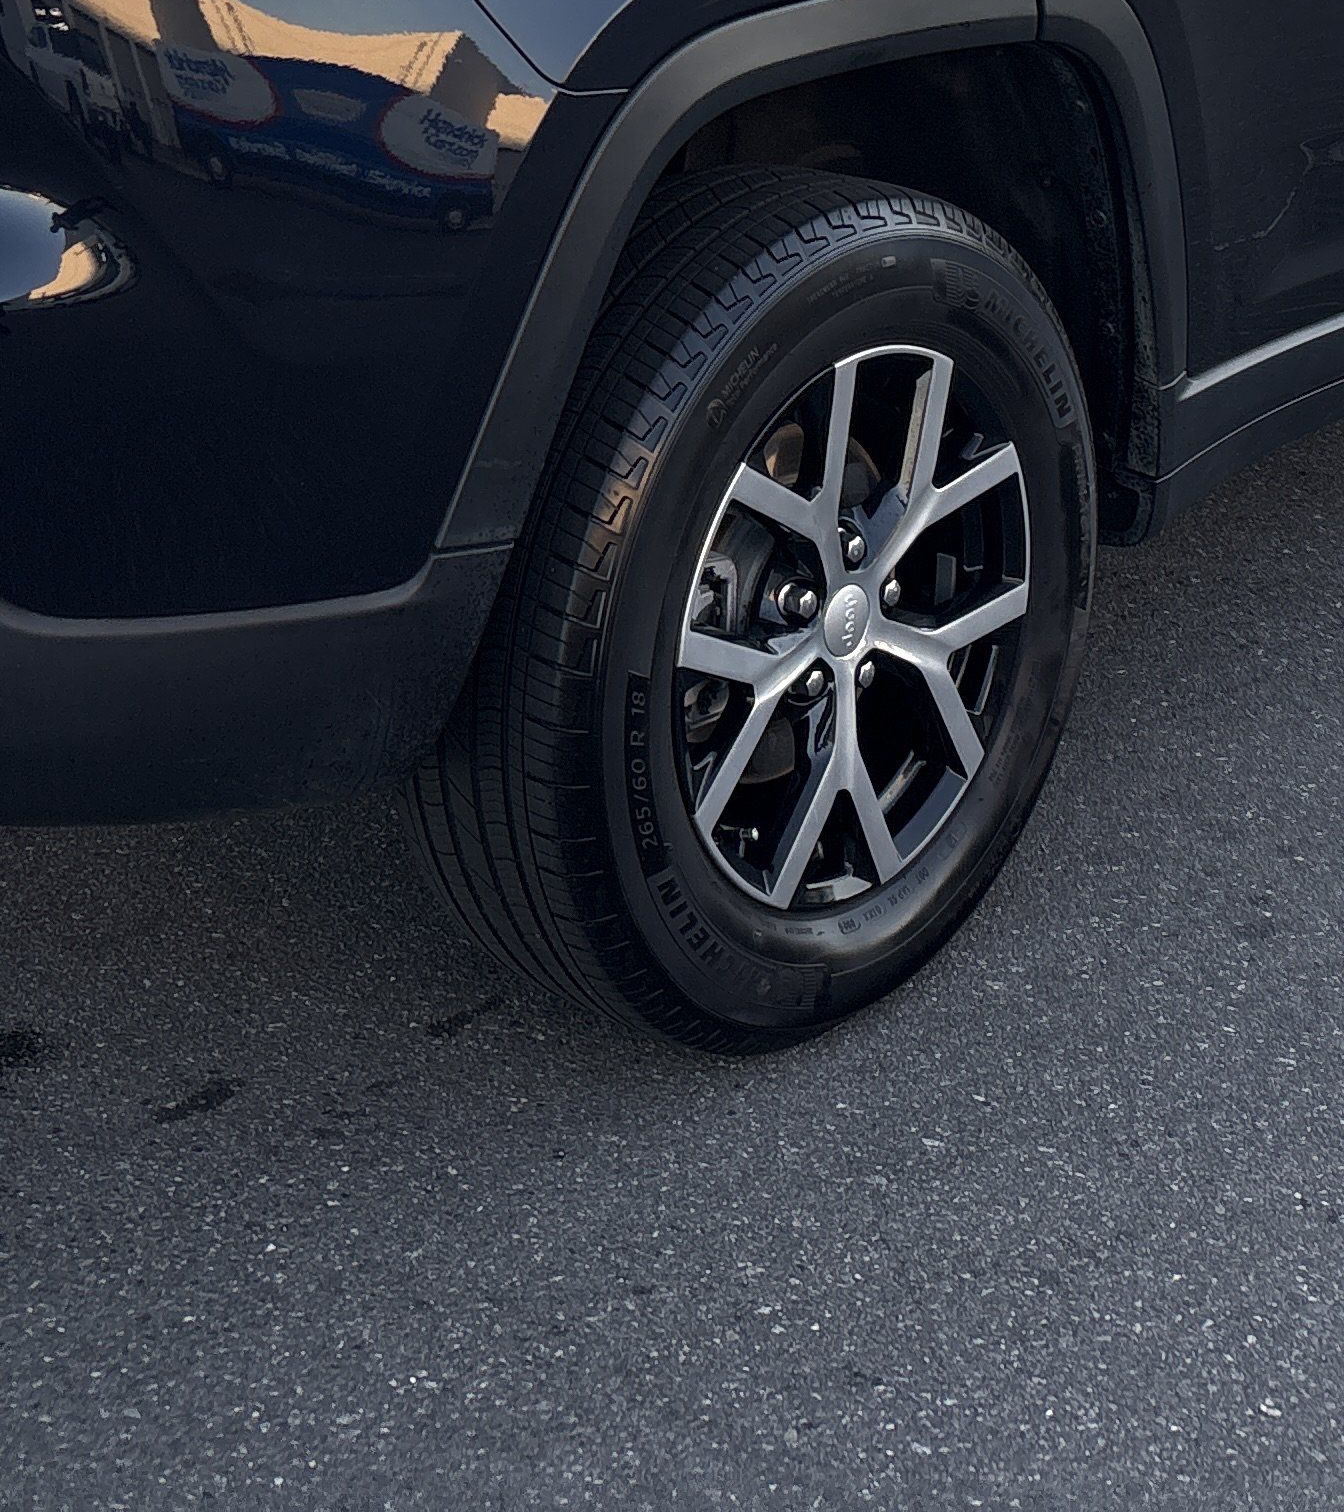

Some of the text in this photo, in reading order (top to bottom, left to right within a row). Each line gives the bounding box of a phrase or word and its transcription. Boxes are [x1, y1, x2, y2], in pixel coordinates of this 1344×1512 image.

[721, 346, 761, 400] MICHELIN
[982, 288, 1072, 420] MICHELIN
[841, 593, 859, 647] Jeep
[630, 691, 659, 850] 265/60 R 18
